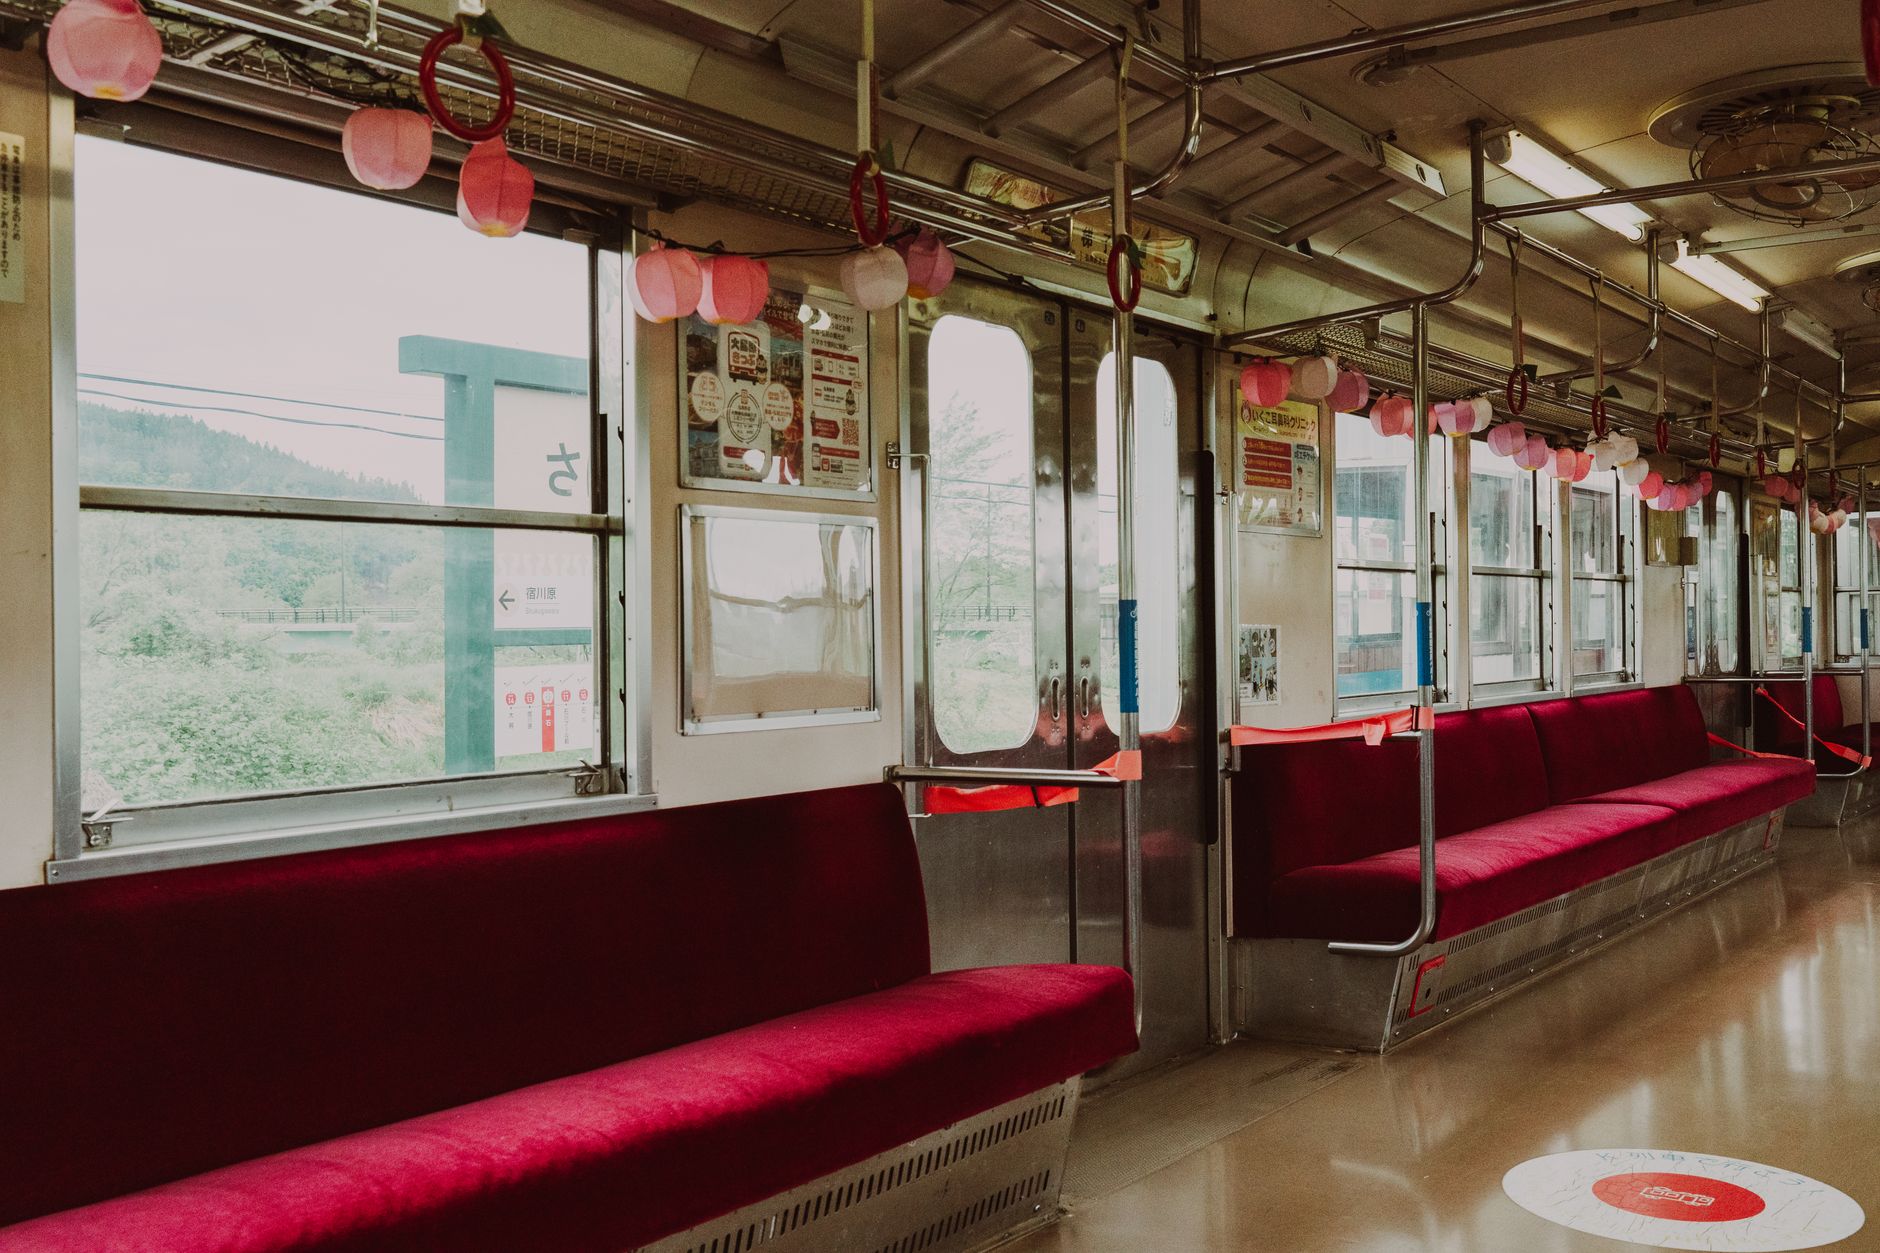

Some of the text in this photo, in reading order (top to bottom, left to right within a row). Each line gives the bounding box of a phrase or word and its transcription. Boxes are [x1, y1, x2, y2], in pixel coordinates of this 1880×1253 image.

[546, 442, 591, 496] さ
[526, 586, 557, 600] 宿川原
